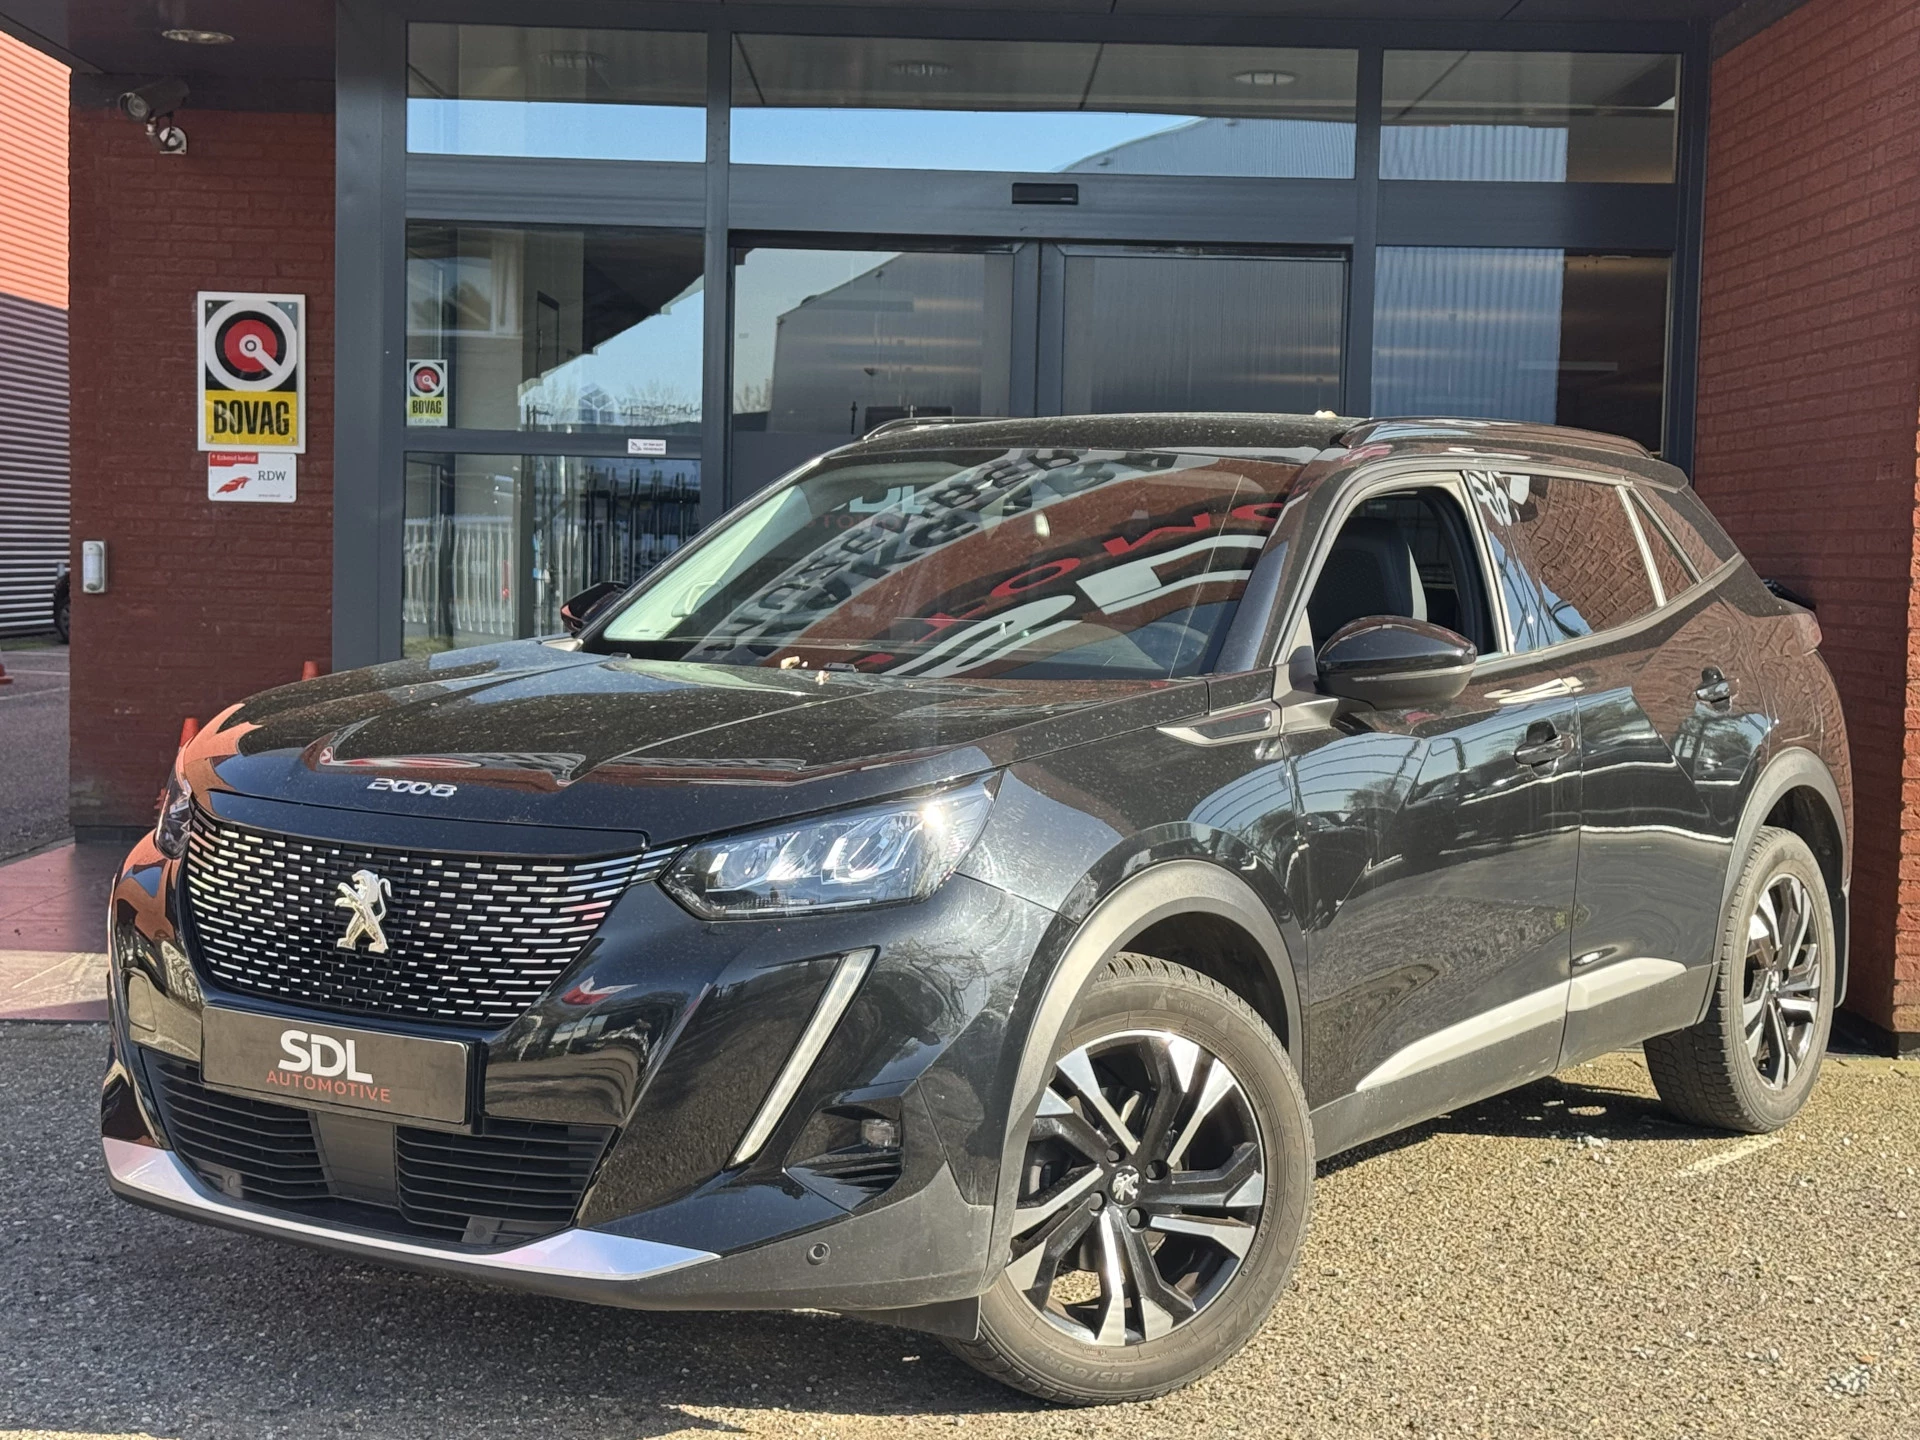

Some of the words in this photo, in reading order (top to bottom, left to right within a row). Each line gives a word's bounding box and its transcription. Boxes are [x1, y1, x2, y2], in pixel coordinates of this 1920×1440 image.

[213, 399, 290, 436] BOVAG
[412, 399, 442, 415] BOVAG
[258, 470, 287, 481] RDW
[277, 1029, 374, 1084] SDL
[266, 1069, 392, 1104] AUTOMOTIVE
